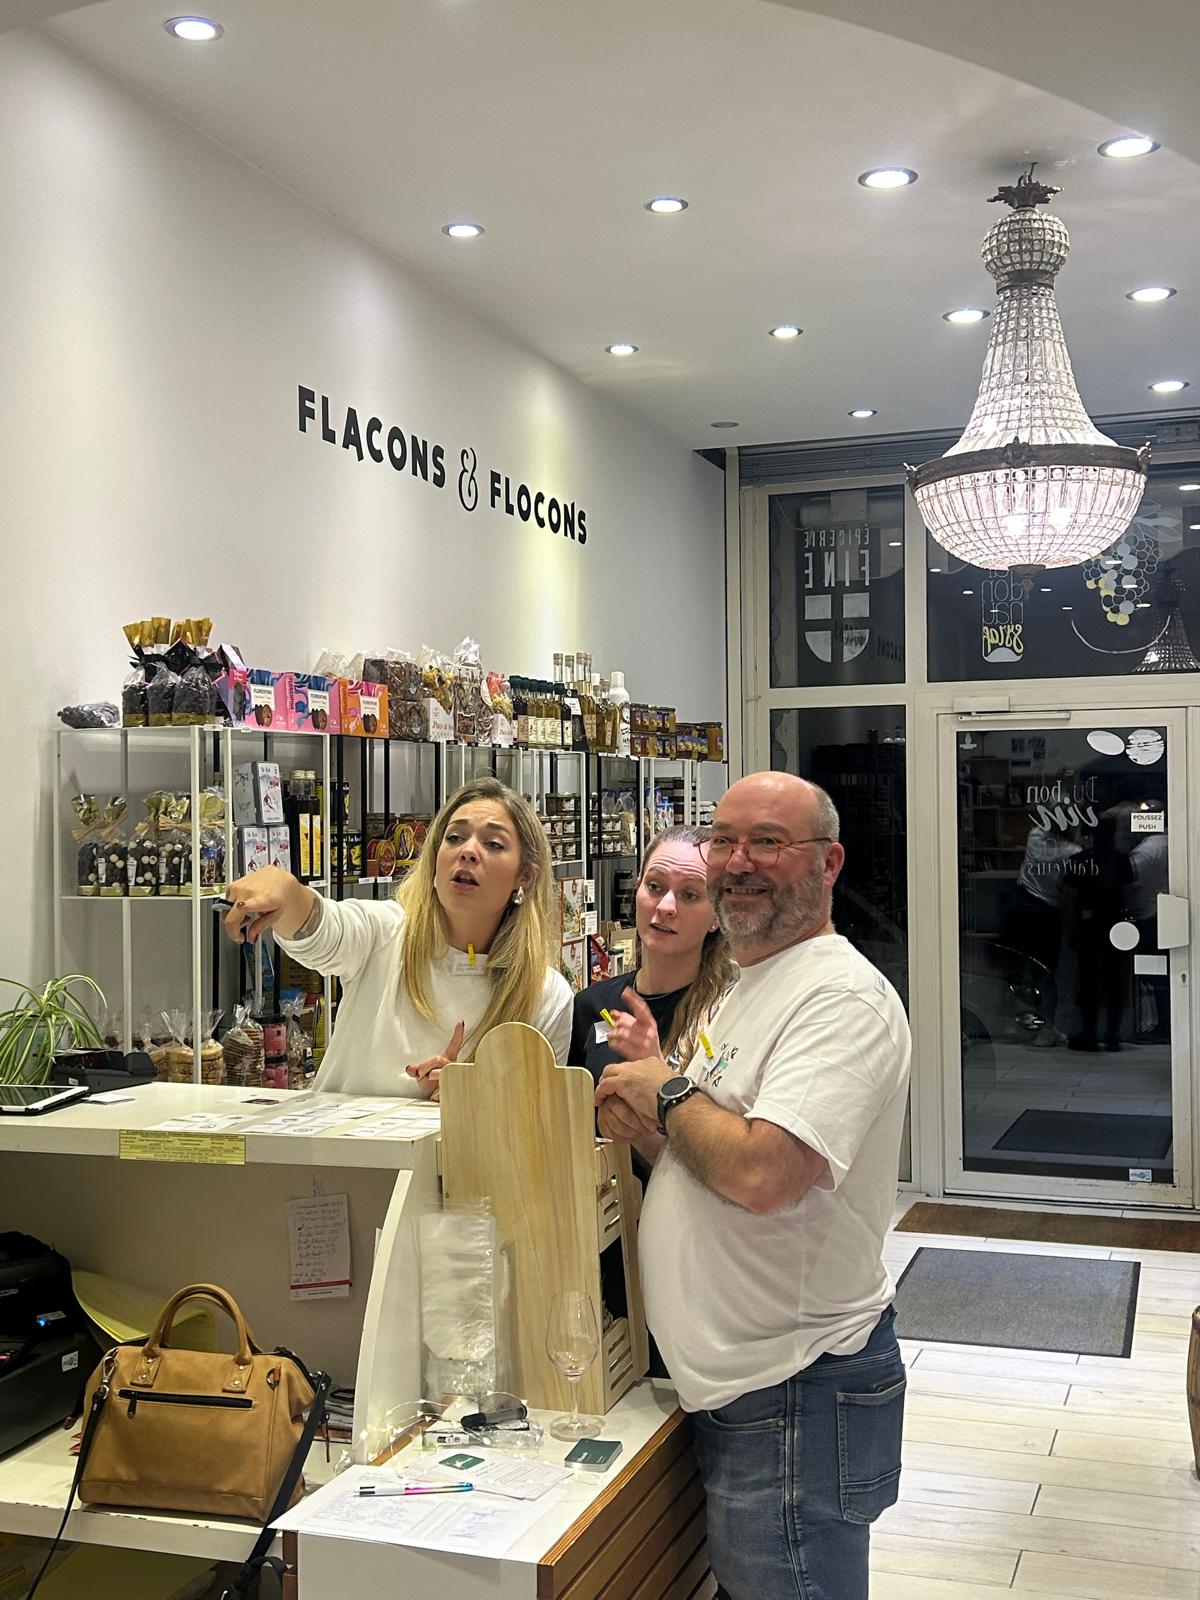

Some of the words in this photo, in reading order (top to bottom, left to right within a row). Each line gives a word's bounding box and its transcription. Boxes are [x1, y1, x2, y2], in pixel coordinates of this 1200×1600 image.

[298, 385, 446, 488] FLACONS
[458, 447, 478, 512] &
[490, 469, 587, 545] FLOCONS
